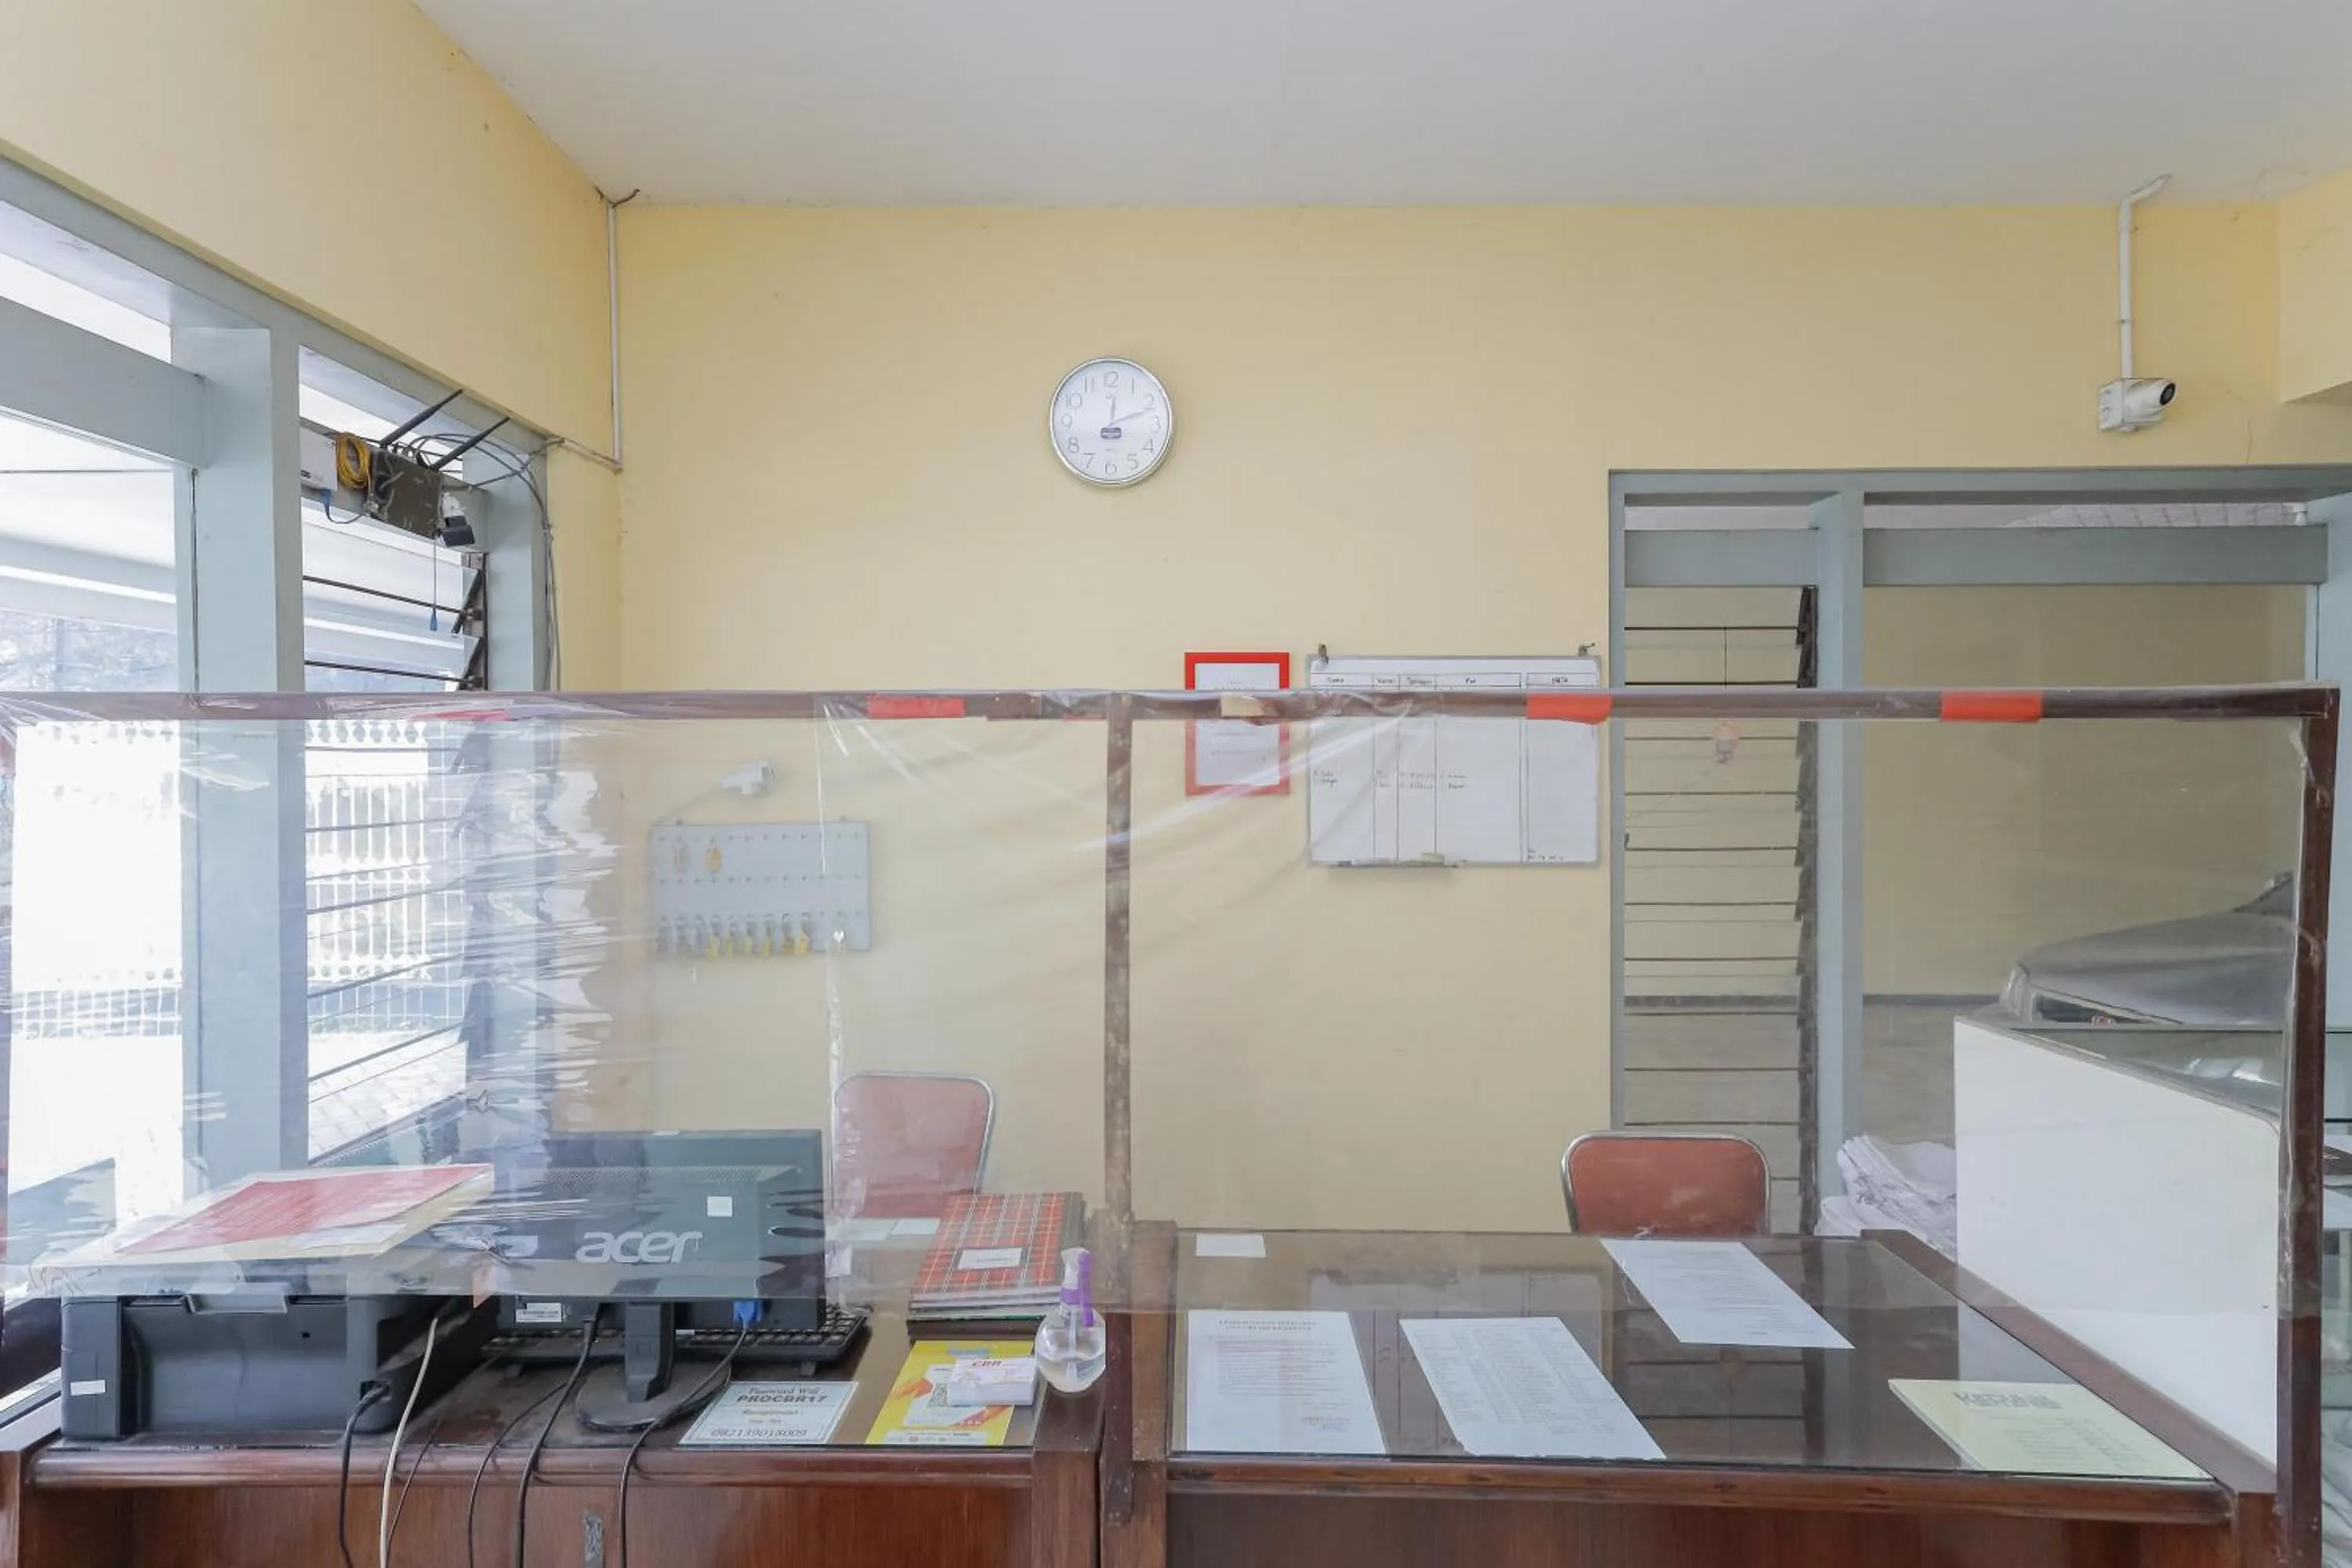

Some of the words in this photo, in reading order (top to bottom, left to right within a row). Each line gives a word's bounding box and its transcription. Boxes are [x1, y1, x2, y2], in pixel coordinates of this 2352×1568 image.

[1084, 376, 1095, 393] 11
[1103, 371, 1119, 388] 12
[1065, 392, 1083, 409] 10
[1144, 394, 1155, 407] 2
[1061, 413, 1073, 429] 9
[1154, 416, 1162, 430] 3
[1068, 437, 1080, 454] 8
[1142, 438, 1154, 454] 4
[1083, 452, 1096, 470] 7
[1127, 453, 1138, 470] 5
[575, 1231, 703, 1265] acer
